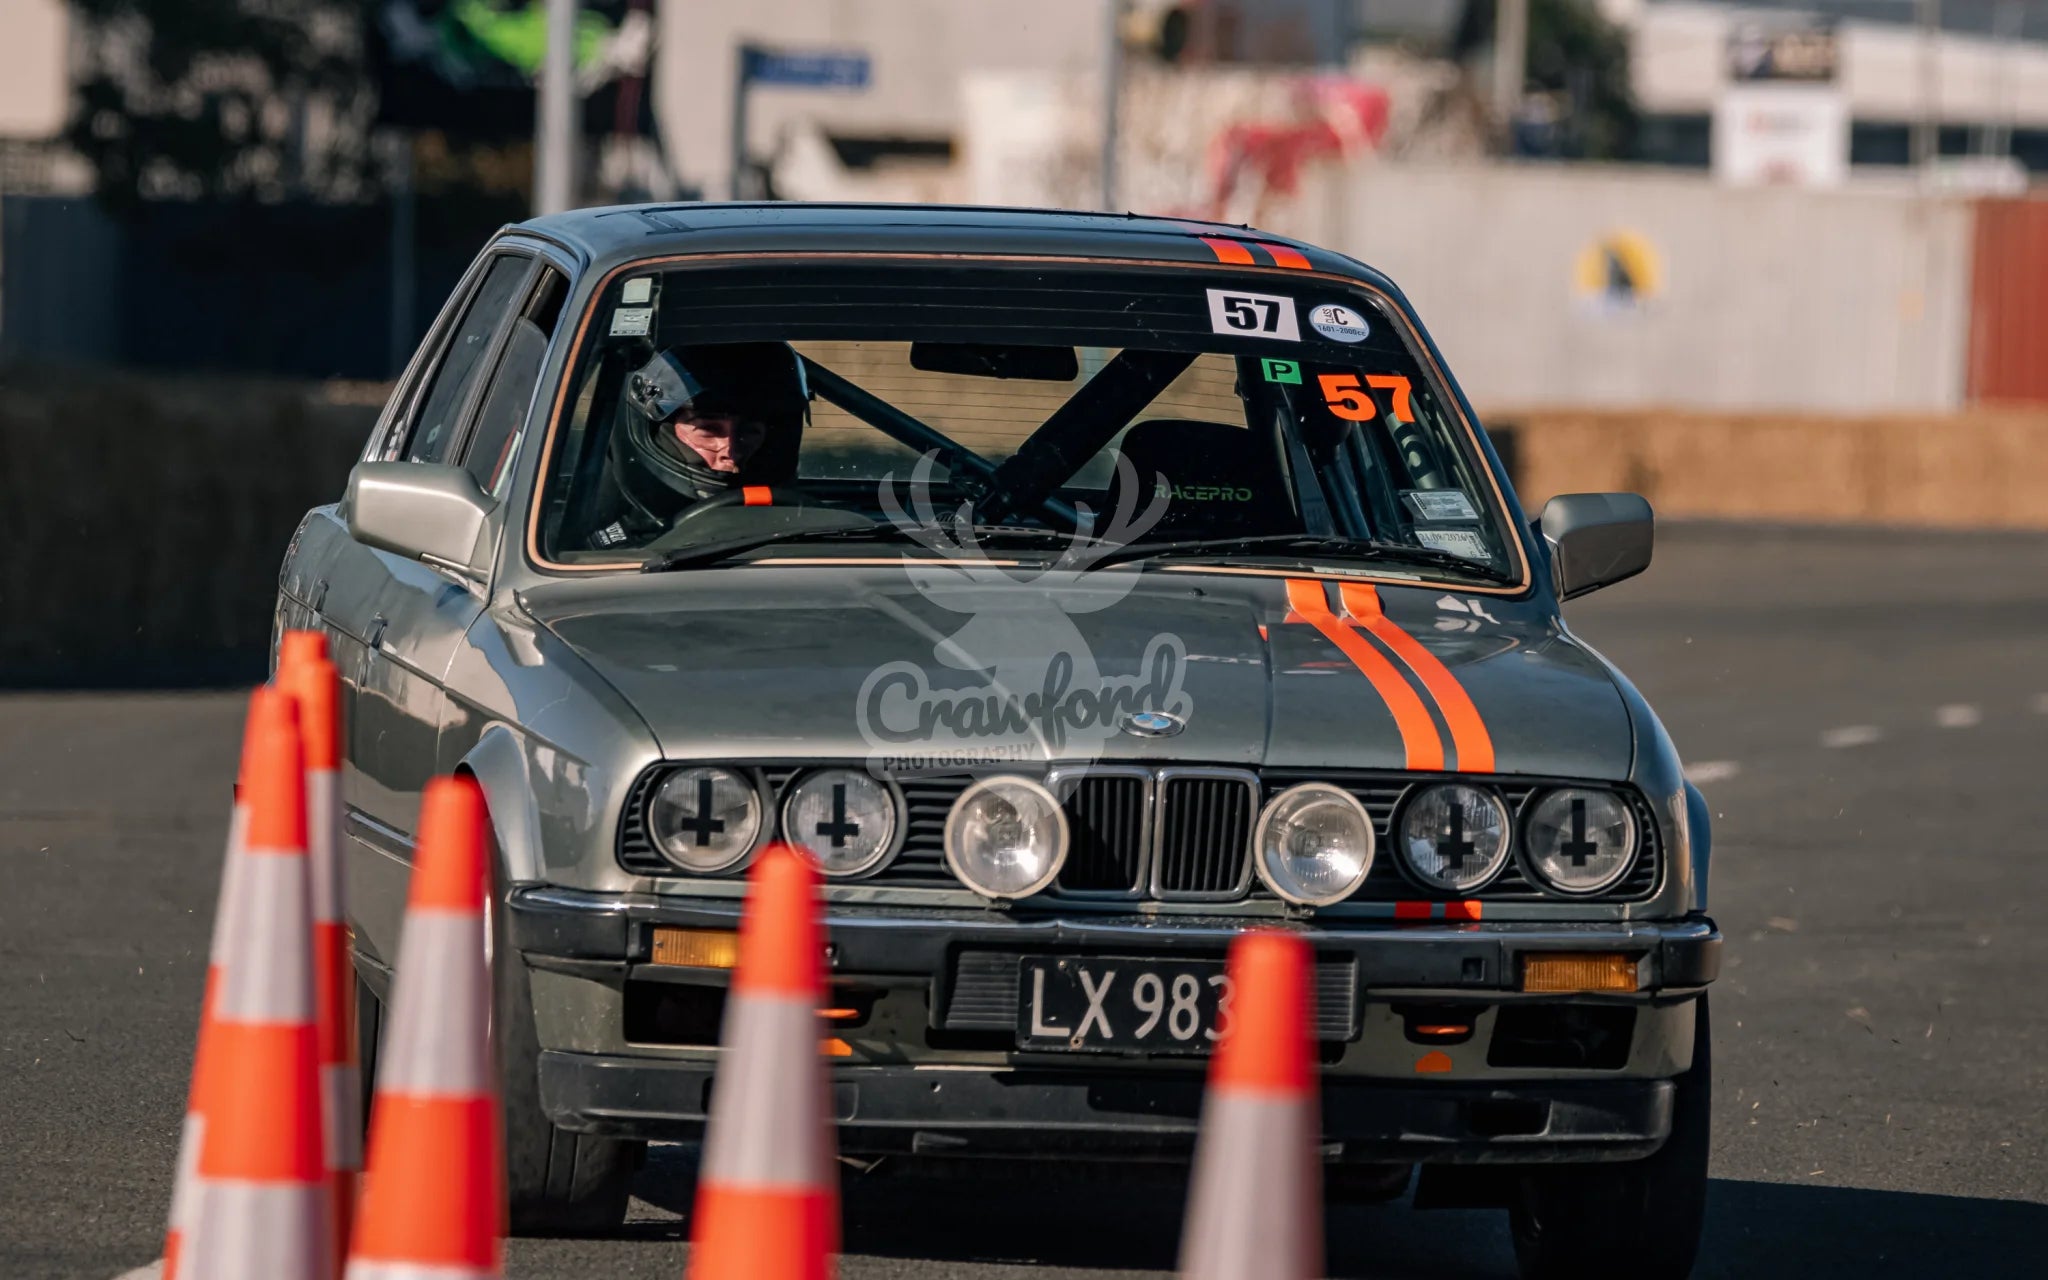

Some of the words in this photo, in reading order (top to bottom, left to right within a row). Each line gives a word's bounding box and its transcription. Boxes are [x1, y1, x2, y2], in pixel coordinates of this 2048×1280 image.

[1223, 296, 1281, 333] 57
[1332, 308, 1348, 325] C
[1268, 361, 1293, 380] P
[1317, 374, 1416, 423] 57
[1154, 485, 1252, 501] RACEPRO
[1031, 968, 1117, 1039] LX
[1132, 973, 1237, 1041] 983
